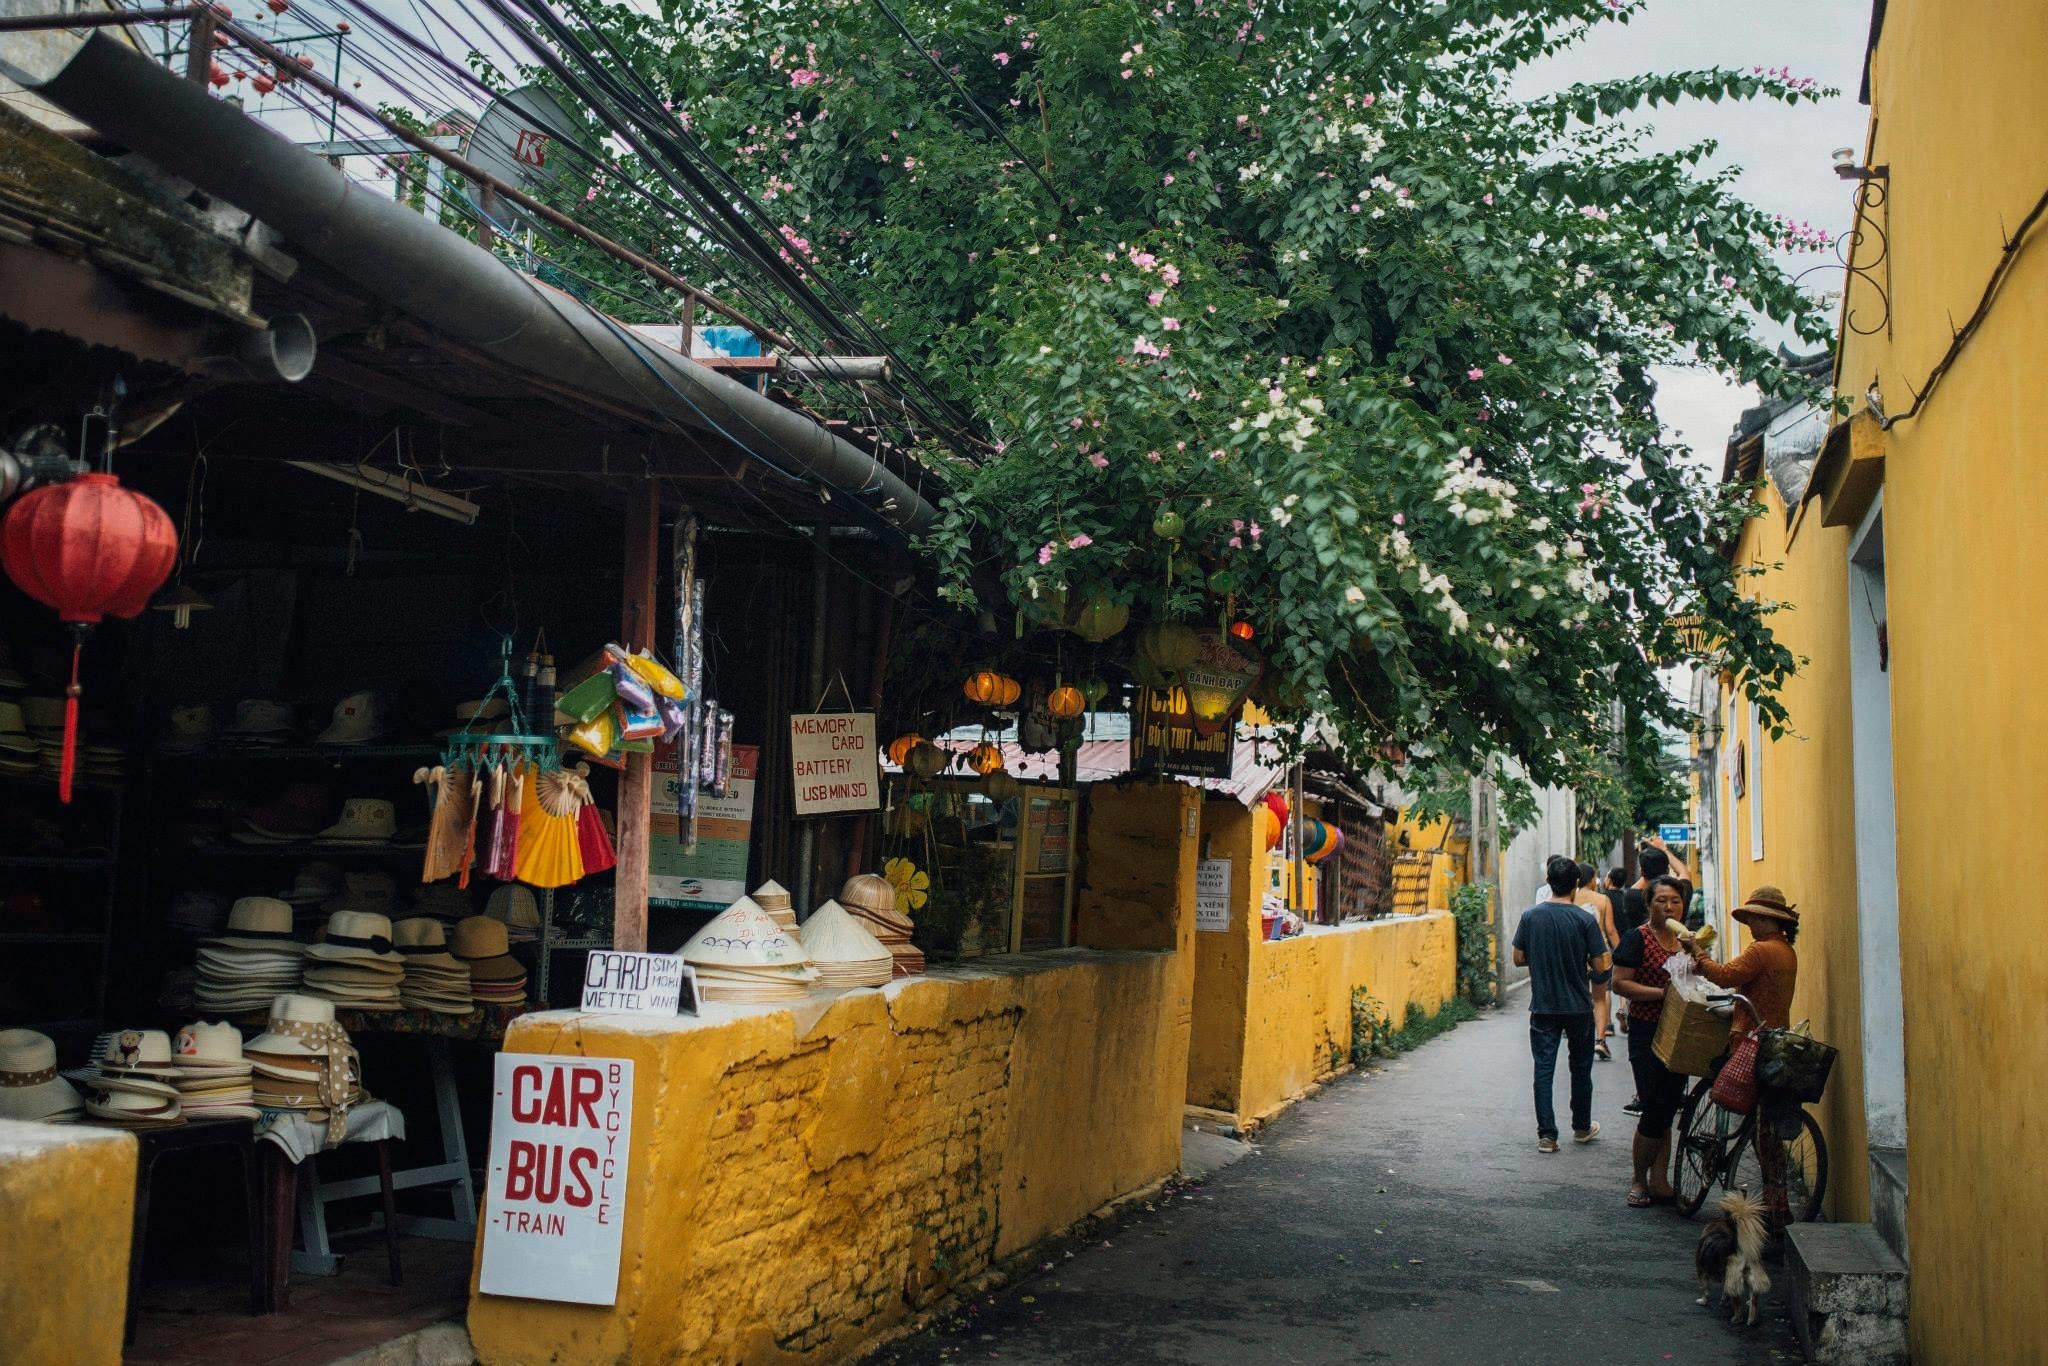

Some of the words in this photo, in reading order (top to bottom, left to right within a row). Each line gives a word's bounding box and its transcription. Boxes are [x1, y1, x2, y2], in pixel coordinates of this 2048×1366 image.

[794, 718, 856, 735] MEMORY
[831, 735, 864, 751] CARD
[796, 758, 852, 776] BATTERY
[803, 785, 828, 802] USB
[829, 784, 850, 799] MINI
[851, 782, 868, 798] SD
[586, 953, 651, 991] CARD
[652, 956, 678, 973] SIM
[584, 991, 644, 1010] VIETTEL
[511, 1065, 603, 1129] CAR
[598, 1063, 621, 1225] BYCYCLE
[505, 1139, 598, 1208] BUS
